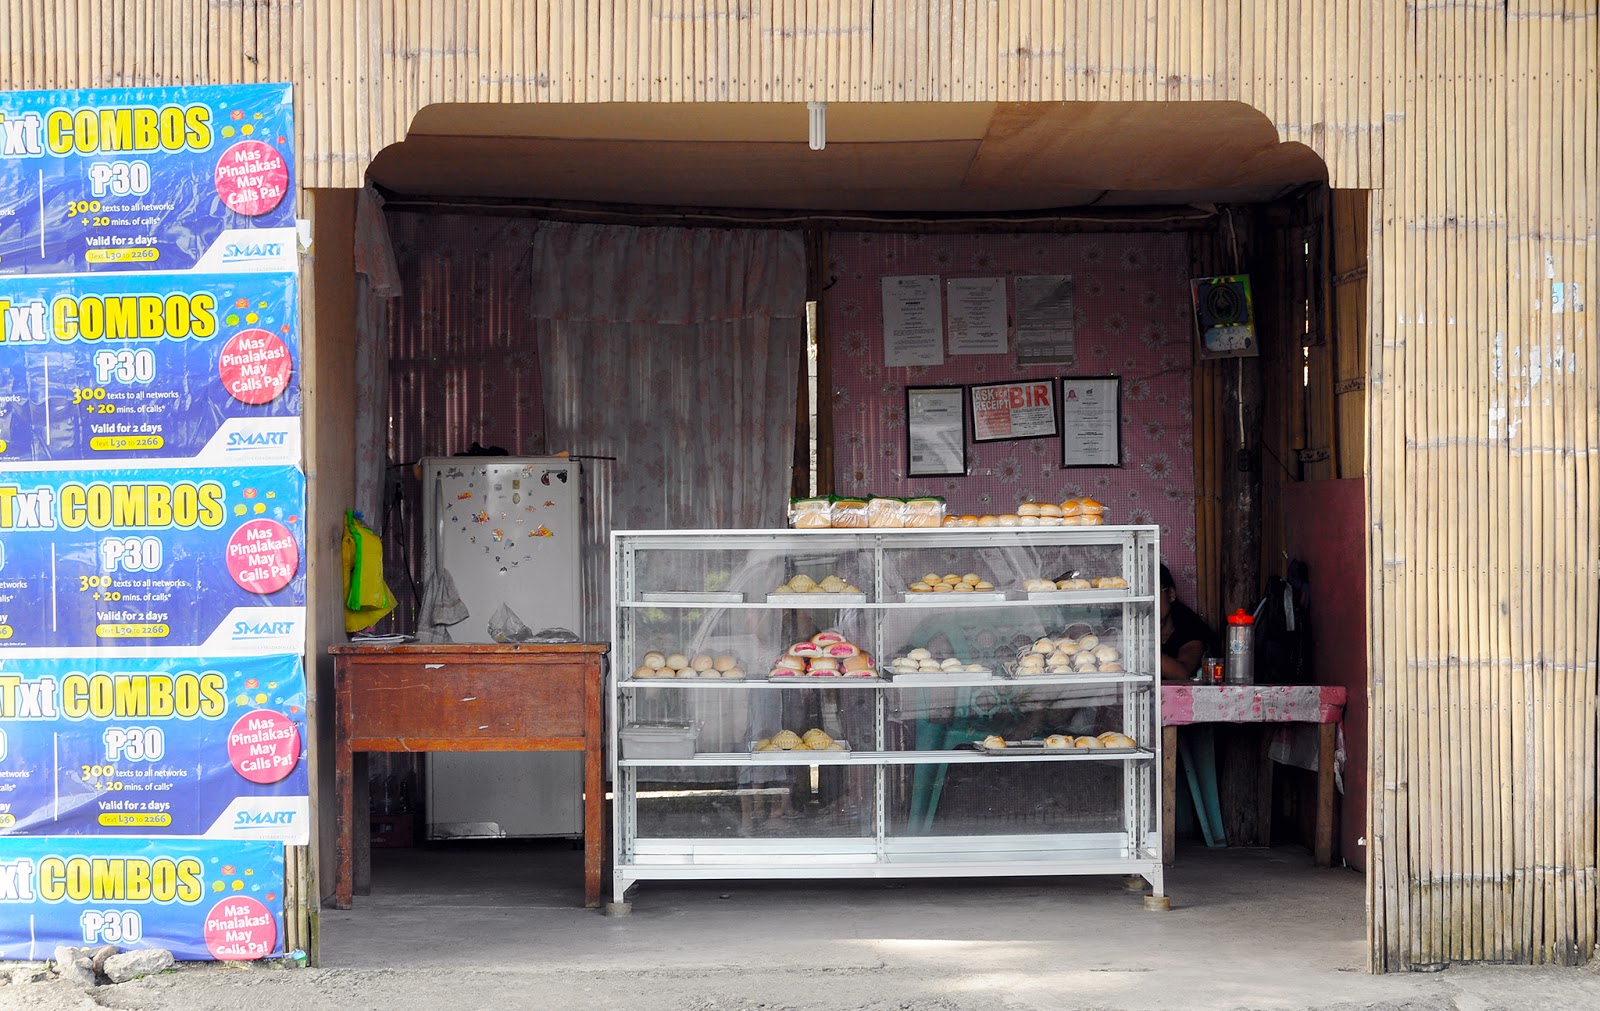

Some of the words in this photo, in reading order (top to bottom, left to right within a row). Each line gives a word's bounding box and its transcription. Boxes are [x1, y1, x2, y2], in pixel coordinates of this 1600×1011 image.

[0, 113, 41, 154] xt
[48, 106, 211, 153] COMBOS
[235, 150, 261, 162] Mas
[218, 157, 281, 177] Pinalakas!
[237, 175, 263, 189] May
[228, 190, 259, 205] Calls
[260, 187, 280, 199] Pa!
[67, 200, 101, 218] 300
[122, 204, 130, 212] to
[131, 203, 140, 212] all
[141, 202, 175, 211] networks
[92, 216, 110, 226] 20
[111, 218, 131, 226] mins.
[132, 217, 140, 226] of
[86, 236, 110, 246] Valid
[112, 236, 126, 246] for
[135, 235, 158, 246] days
[131, 250, 154, 258] 2266
[223, 243, 284, 257] SMART
[53, 294, 216, 340] COMBOS
[239, 338, 265, 351] Mas
[223, 347, 284, 366] Pinalakas!
[241, 364, 268, 378] May
[232, 379, 262, 393] Calls
[264, 375, 283, 388] Pa!
[72, 387, 106, 404] 300
[127, 391, 135, 399] to
[136, 391, 145, 399] all
[146, 390, 179, 398] networks
[975, 388, 995, 401] ASK
[995, 389, 1008, 398] FOR
[1009, 385, 1050, 408] BIR
[97, 404, 115, 414] 20
[116, 405, 136, 413] mins.
[137, 404, 145, 413] of
[975, 399, 1009, 410] RECEIPT
[91, 423, 115, 433] Valid
[117, 422, 131, 433] for
[140, 422, 162, 434] days
[110, 438, 127, 448] L30
[136, 437, 158, 446] 2266
[227, 432, 288, 445] SMART
[61, 484, 223, 527] COMBOS
[247, 528, 273, 541] Mas
[230, 536, 292, 556] Pinalakas!
[249, 553, 275, 568] May
[239, 569, 270, 583] Calls
[271, 566, 291, 577] Pa!
[79, 575, 112, 592] 300
[133, 579, 141, 587] to
[142, 579, 151, 587] all
[152, 579, 186, 588] networks
[103, 591, 122, 601] 20
[122, 593, 142, 601] mins.
[143, 593, 151, 601] of
[97, 611, 120, 620] Valid
[122, 611, 137, 620] for
[145, 611, 168, 623] days
[115, 626, 132, 635] L30
[141, 626, 164, 634] 2266
[233, 622, 295, 634] SMART
[63, 674, 224, 718] COMBOS
[249, 719, 274, 731] Mas
[232, 726, 294, 746] Pinalakas!
[250, 743, 276, 757] May
[240, 758, 271, 772] Calls
[273, 754, 293, 767] Pa!
[81, 765, 114, 781] 300
[135, 769, 143, 777] to
[144, 769, 153, 777] all
[154, 769, 187, 777] networks
[106, 781, 123, 791] 20
[124, 783, 144, 791] mins.
[145, 783, 153, 791] of
[99, 800, 123, 810] Valid
[124, 800, 139, 810] for
[147, 800, 170, 812] days
[118, 815, 134, 824] L30
[144, 815, 166, 823] 2266
[235, 811, 296, 824] SMART
[40, 857, 202, 901] COMBOS
[224, 905, 250, 917] Mas
[208, 913, 270, 931] Pinalakas!
[226, 930, 252, 943] May
[216, 944, 247, 954] Calls
[248, 941, 268, 953] Pa!
